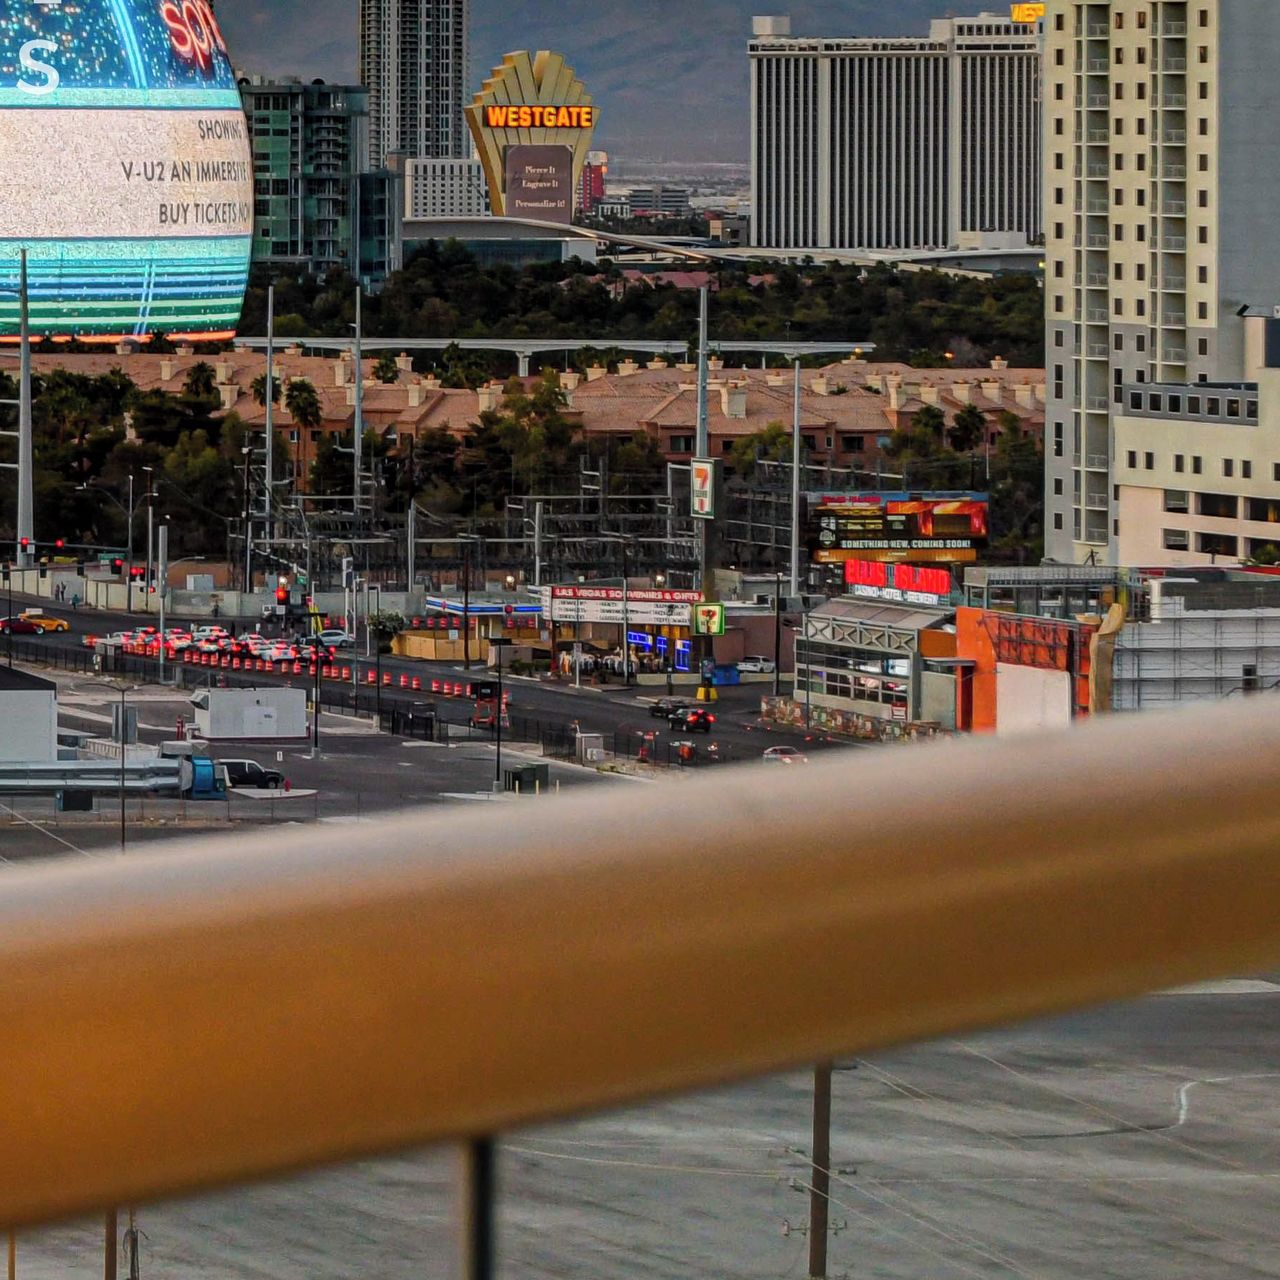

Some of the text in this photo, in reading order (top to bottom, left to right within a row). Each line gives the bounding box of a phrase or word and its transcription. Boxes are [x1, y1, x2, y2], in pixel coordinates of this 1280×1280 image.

[487, 106, 592, 127] WESTGATE
[121, 161, 247, 182] V-U2 AN IMMERSIVE
[158, 203, 190, 224] BUY
[194, 203, 237, 224] TICKETS
[841, 540, 889, 548] SOMETHING
[912, 540, 945, 548] COMING
[555, 587, 574, 597] LAS
[576, 588, 606, 598] VEGAS
